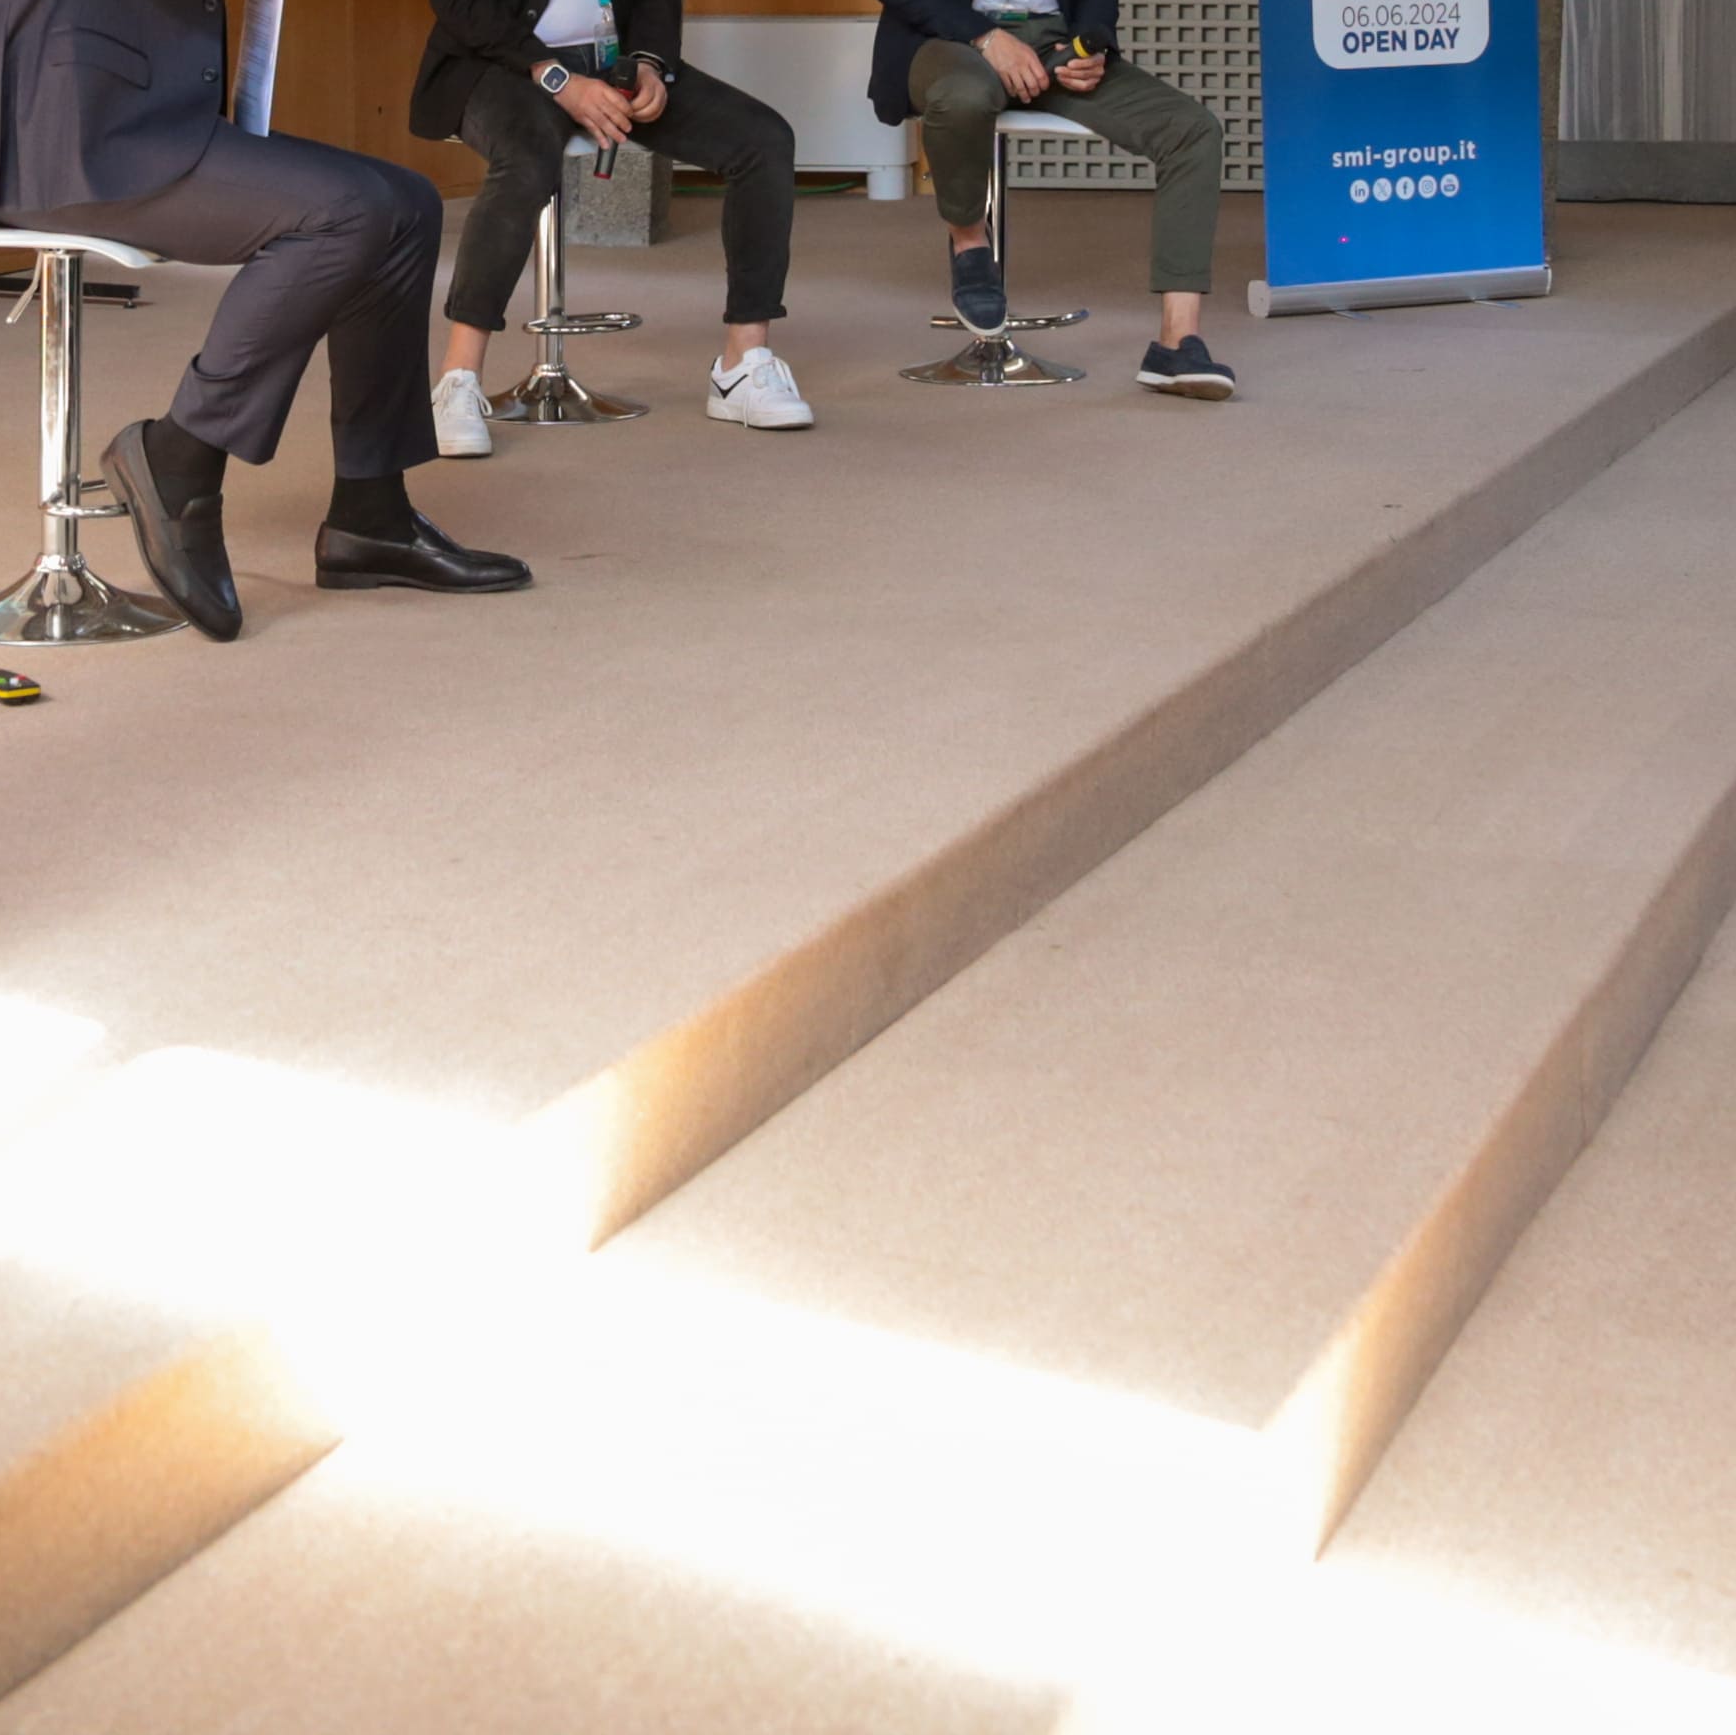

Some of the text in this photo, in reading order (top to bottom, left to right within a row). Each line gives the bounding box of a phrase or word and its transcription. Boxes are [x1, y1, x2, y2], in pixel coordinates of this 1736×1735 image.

[1342, 2, 1461, 28] 06.06.2024
[1342, 27, 1460, 54] OPEN DAY
[1332, 140, 1476, 168] smi-group.it
